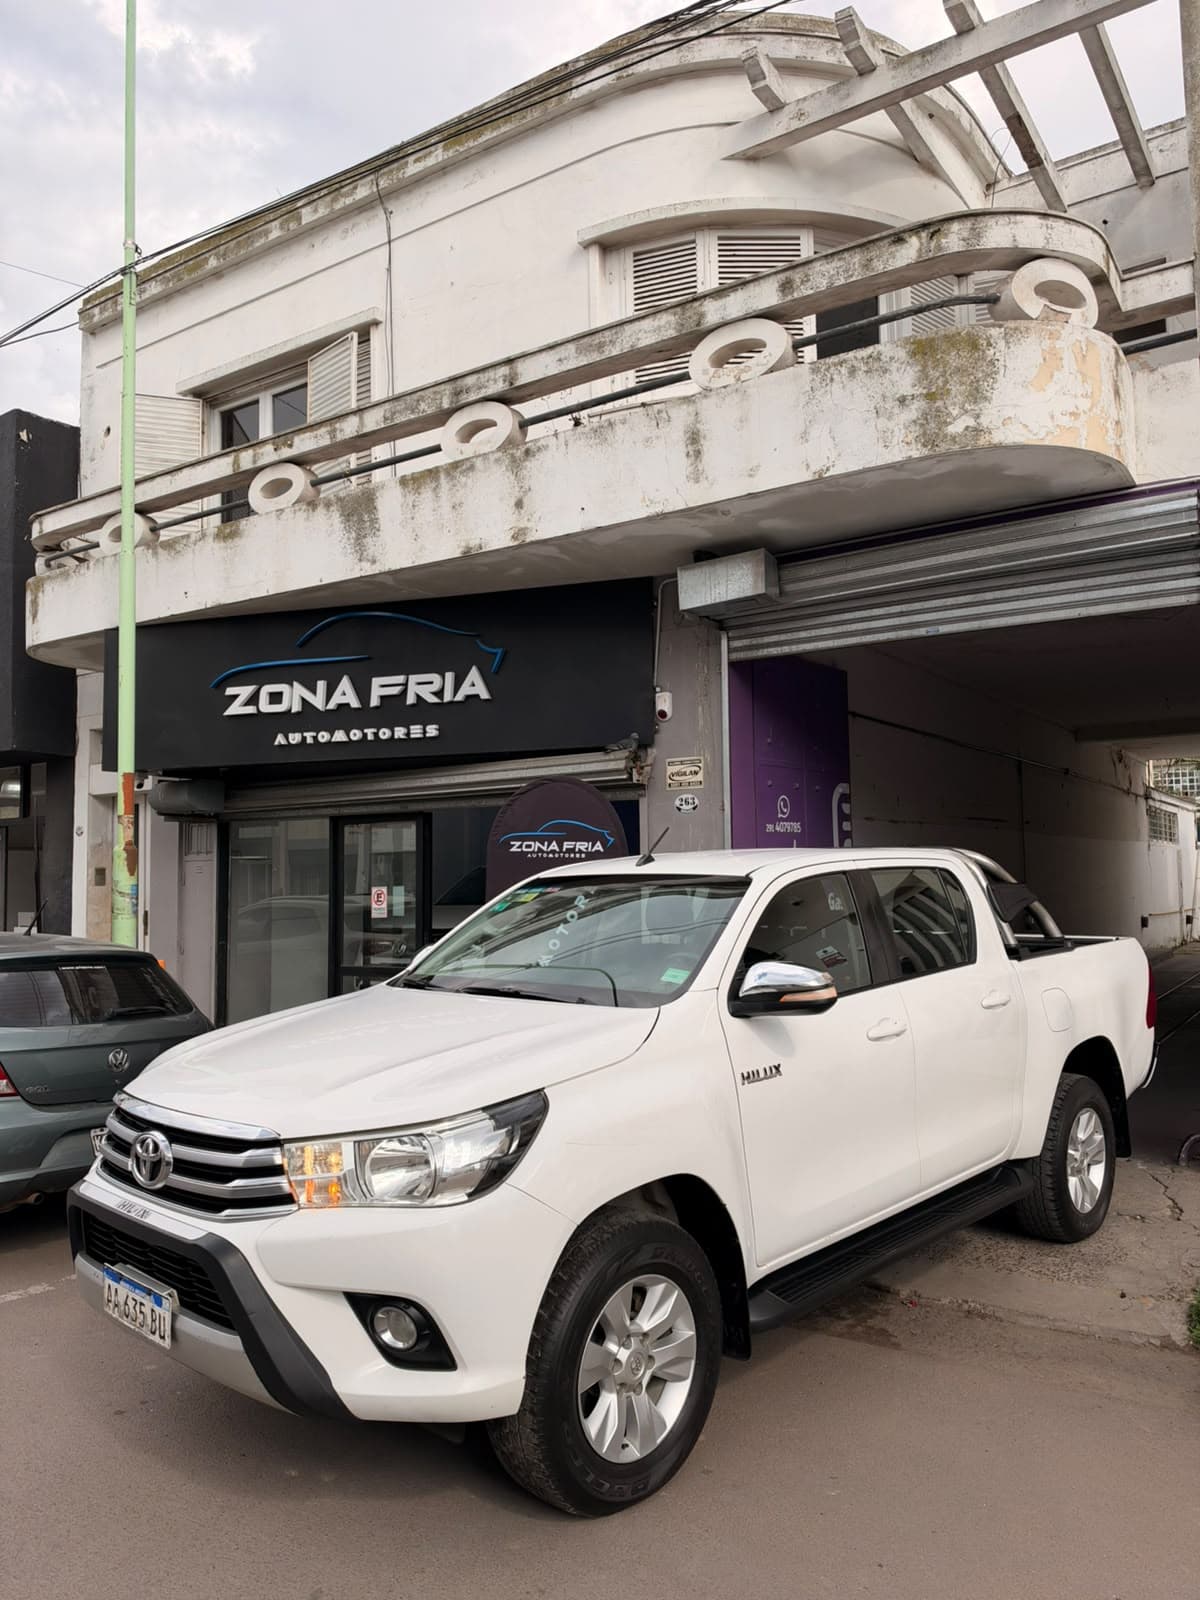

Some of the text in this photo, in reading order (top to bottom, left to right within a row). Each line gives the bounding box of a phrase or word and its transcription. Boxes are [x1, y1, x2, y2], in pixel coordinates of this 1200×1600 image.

[223, 664, 492, 716] ZONA FRIA
[273, 724, 440, 746] AUTOMOTORES
[679, 797, 696, 806] 263
[509, 840, 604, 852] ZONA FRIA
[741, 1063, 782, 1086] HILUX
[105, 1283, 120, 1314] AA
[124, 1294, 146, 1328] 635
[150, 1308, 166, 1340] BU
